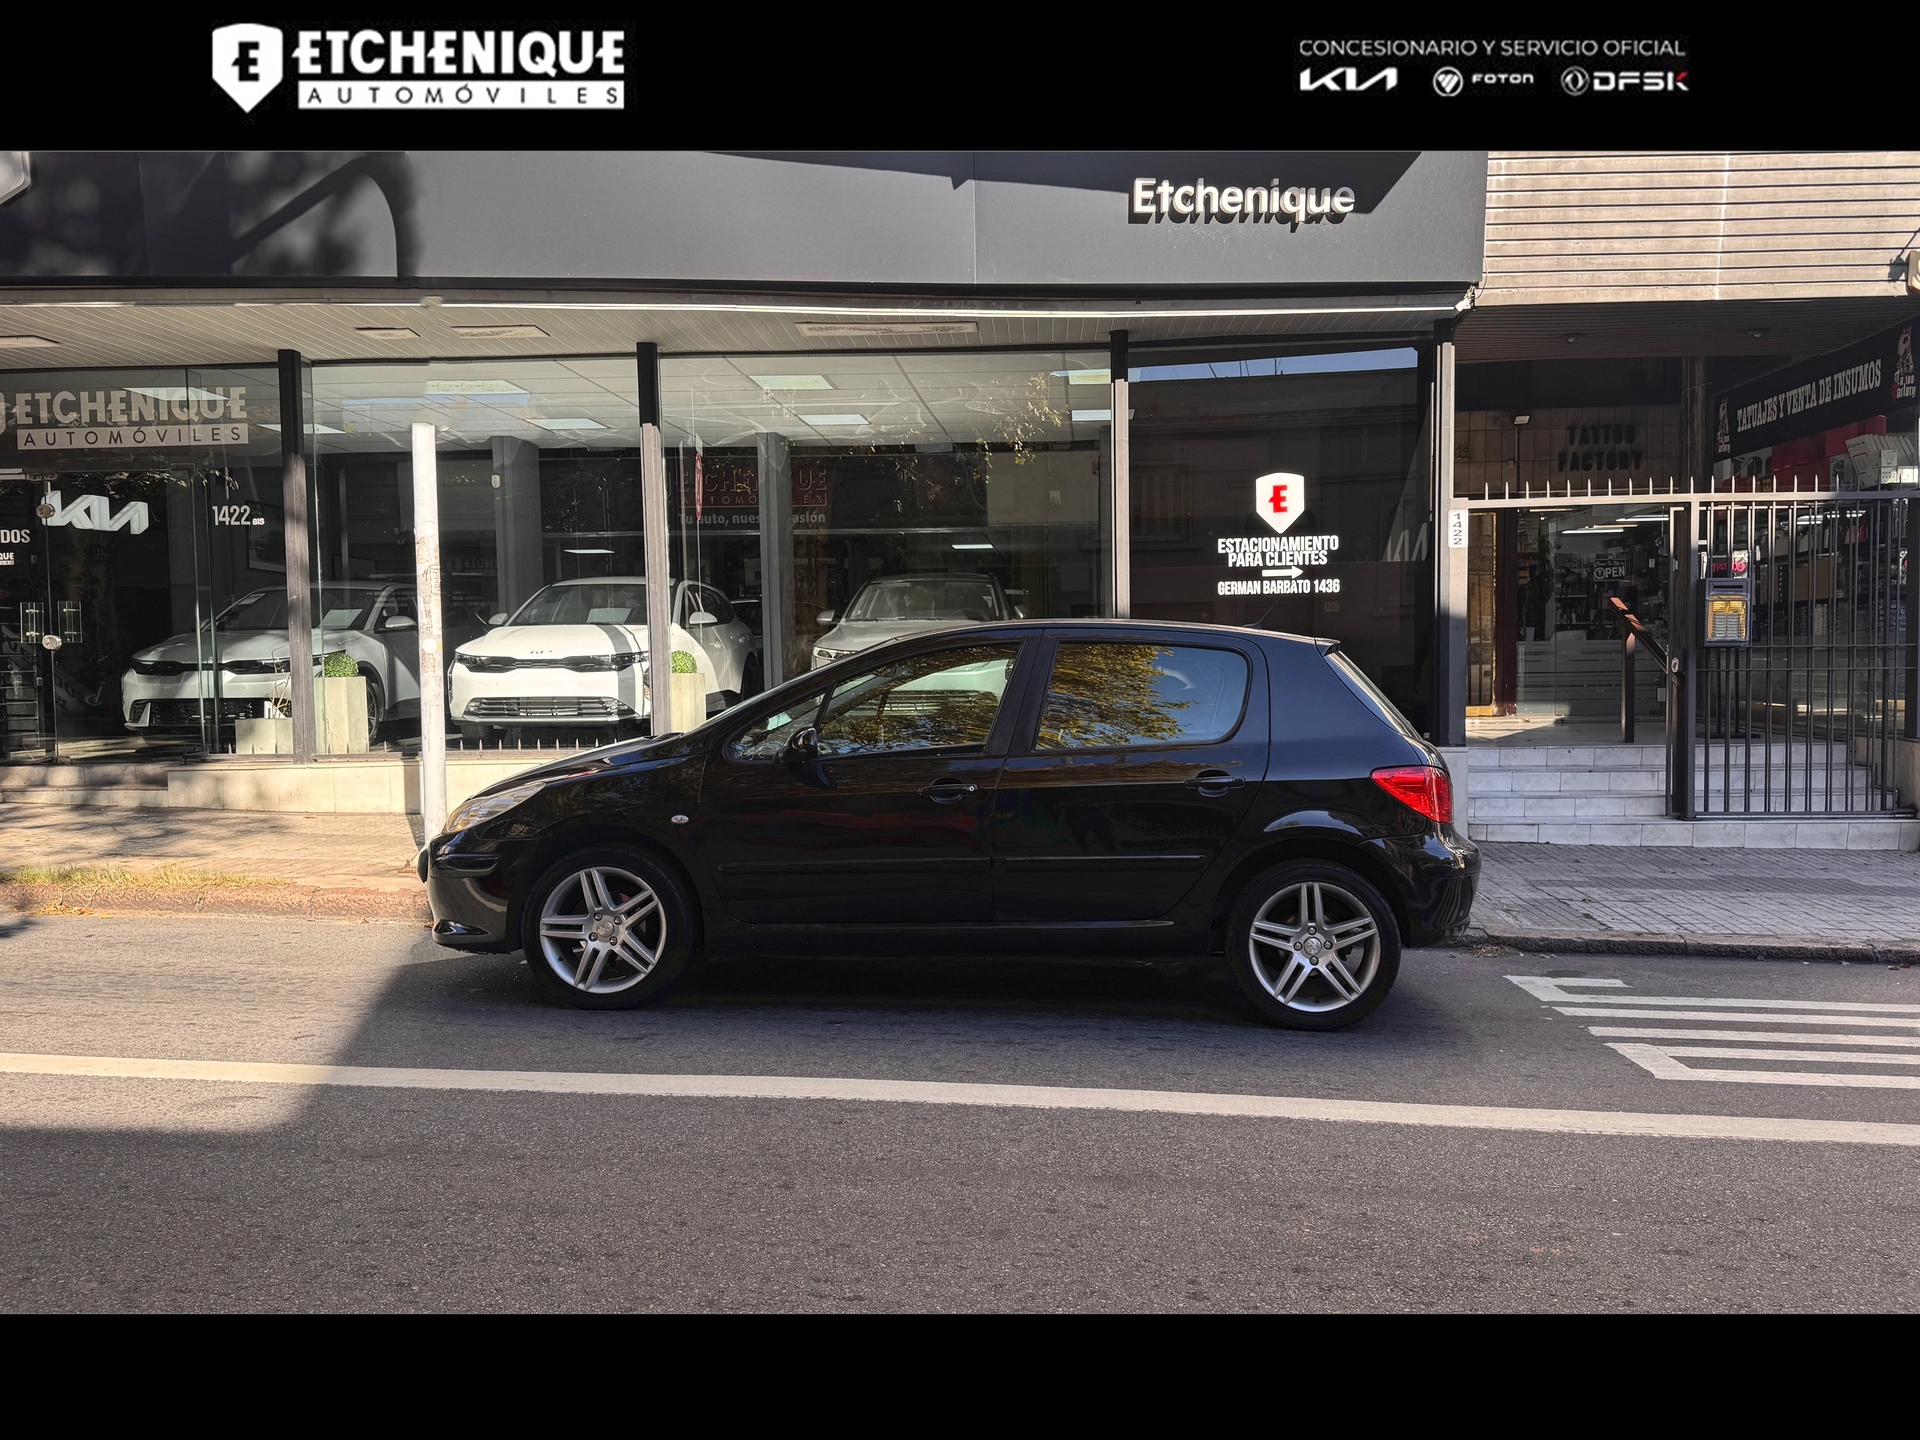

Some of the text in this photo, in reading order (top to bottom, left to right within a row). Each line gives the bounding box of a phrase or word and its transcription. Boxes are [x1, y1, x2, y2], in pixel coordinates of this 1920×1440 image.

[1133, 177, 1356, 223] Etchenique
[12, 386, 248, 425] ETCHENIQUE
[1737, 358, 1882, 432] TATUAJES Y VENTA DE INSUMOS
[23, 426, 241, 447] AUTOMÓVILES
[1567, 424, 1636, 446] TATTOO
[1557, 451, 1644, 472] FACTORY
[212, 504, 266, 526] 1422 BIS
[1452, 512, 1463, 546] 1422
[1217, 534, 1340, 554] ESTACIONAMIENTO
[1227, 550, 1329, 568] PARA CLIENTES
[1593, 566, 1626, 580] OPEN
[1217, 578, 1341, 596] GERMAN BARBATO 1436
